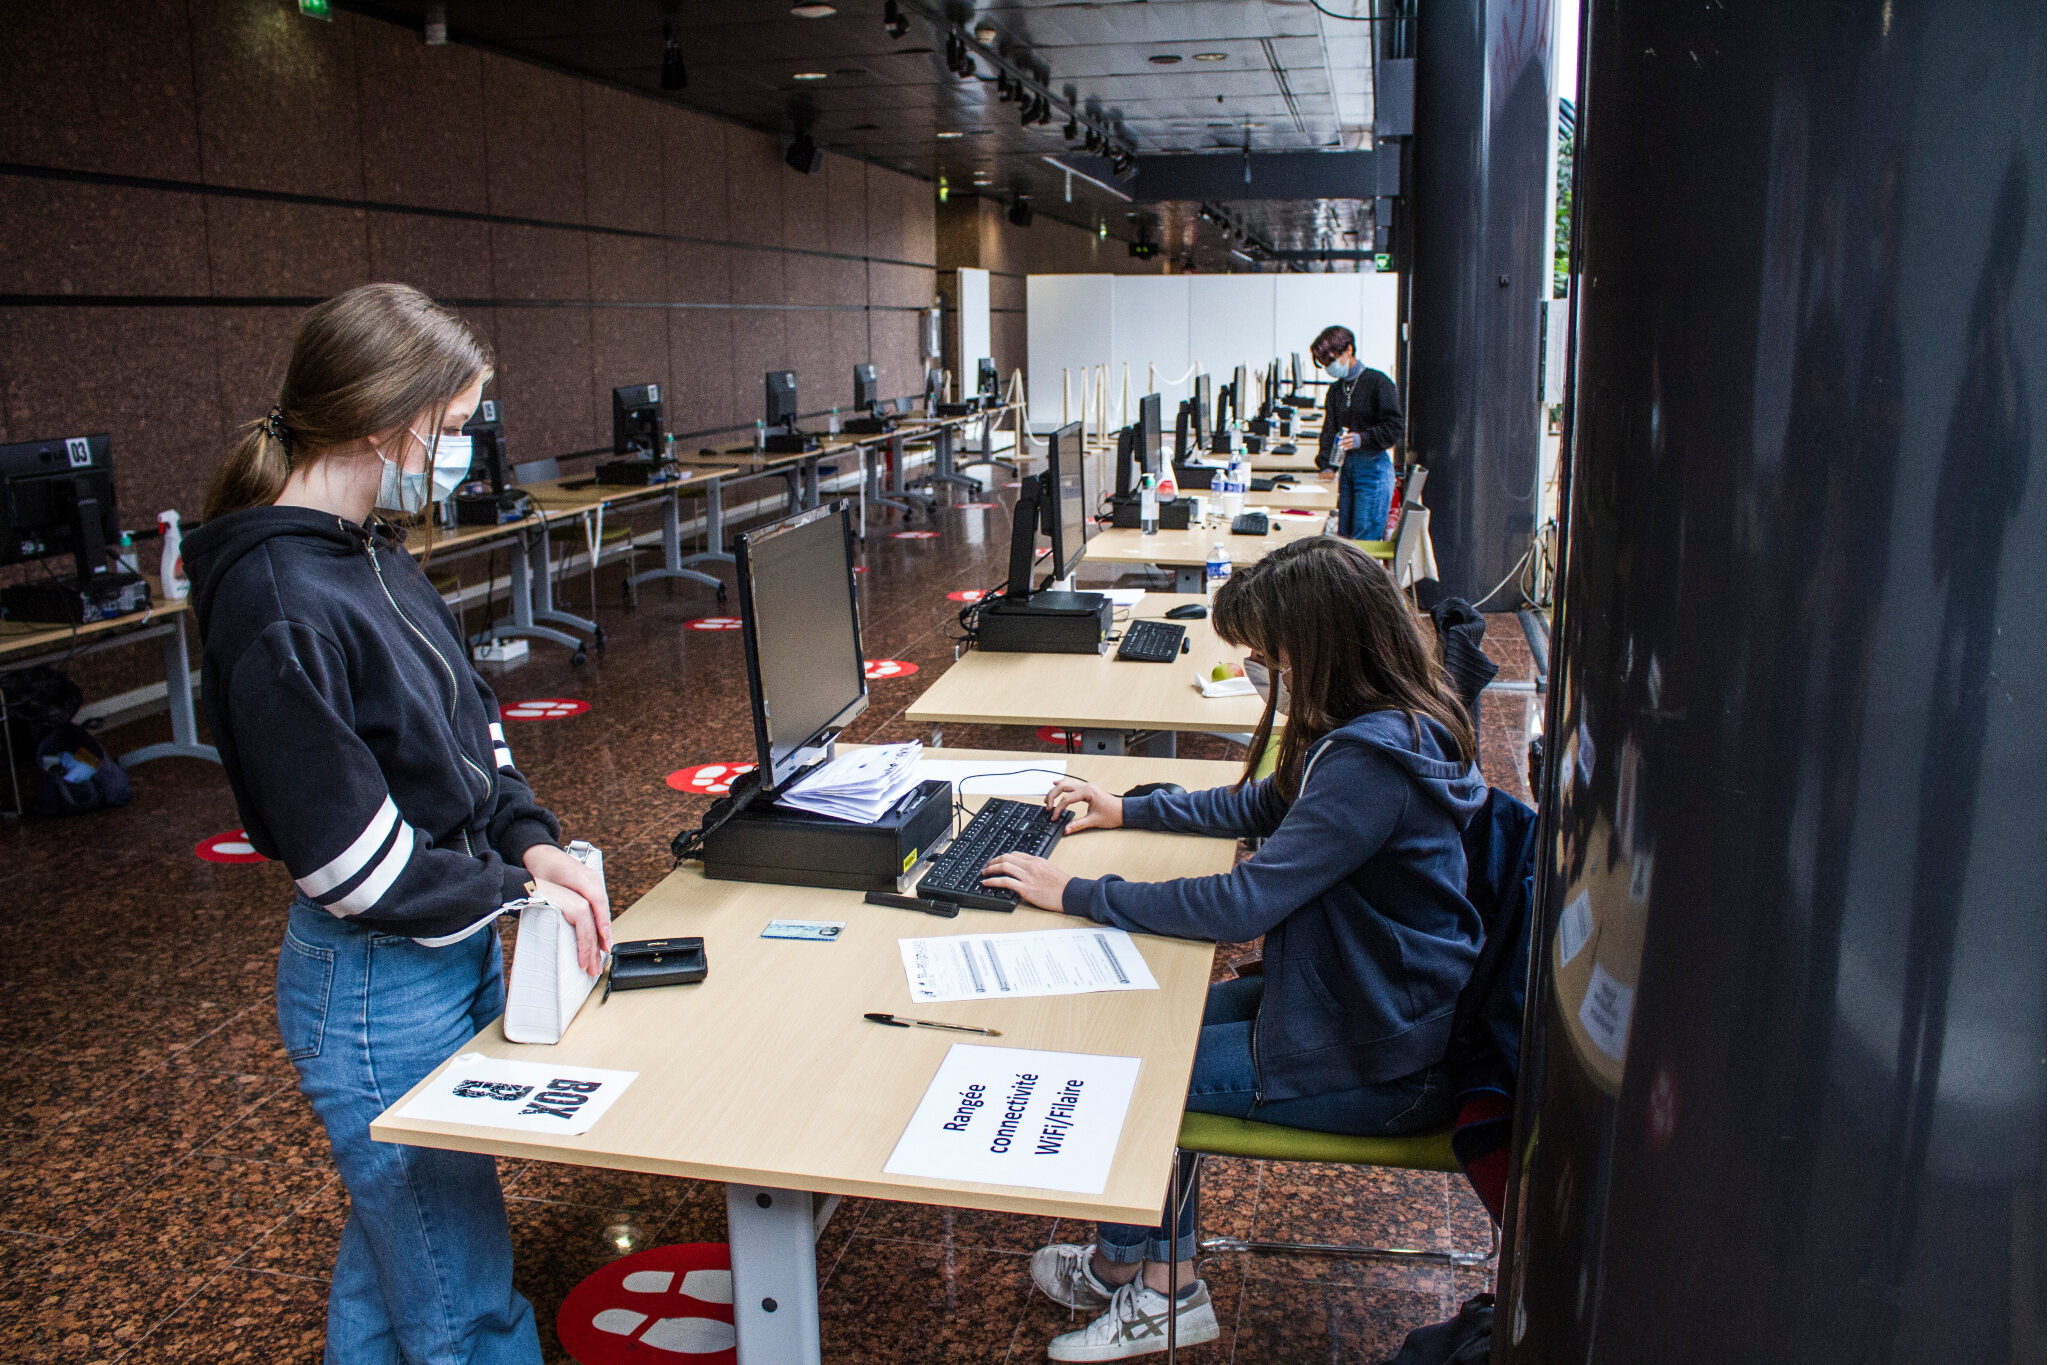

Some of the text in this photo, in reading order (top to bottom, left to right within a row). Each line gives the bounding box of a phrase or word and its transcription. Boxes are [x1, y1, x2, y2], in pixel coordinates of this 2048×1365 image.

[70, 442, 88, 462] 03
[518, 1078, 603, 1120] BOX
[943, 1084, 986, 1132] Rangée
[990, 1073, 1039, 1155] connectivité
[1034, 1079, 1084, 1155] WiFi/Filaire
